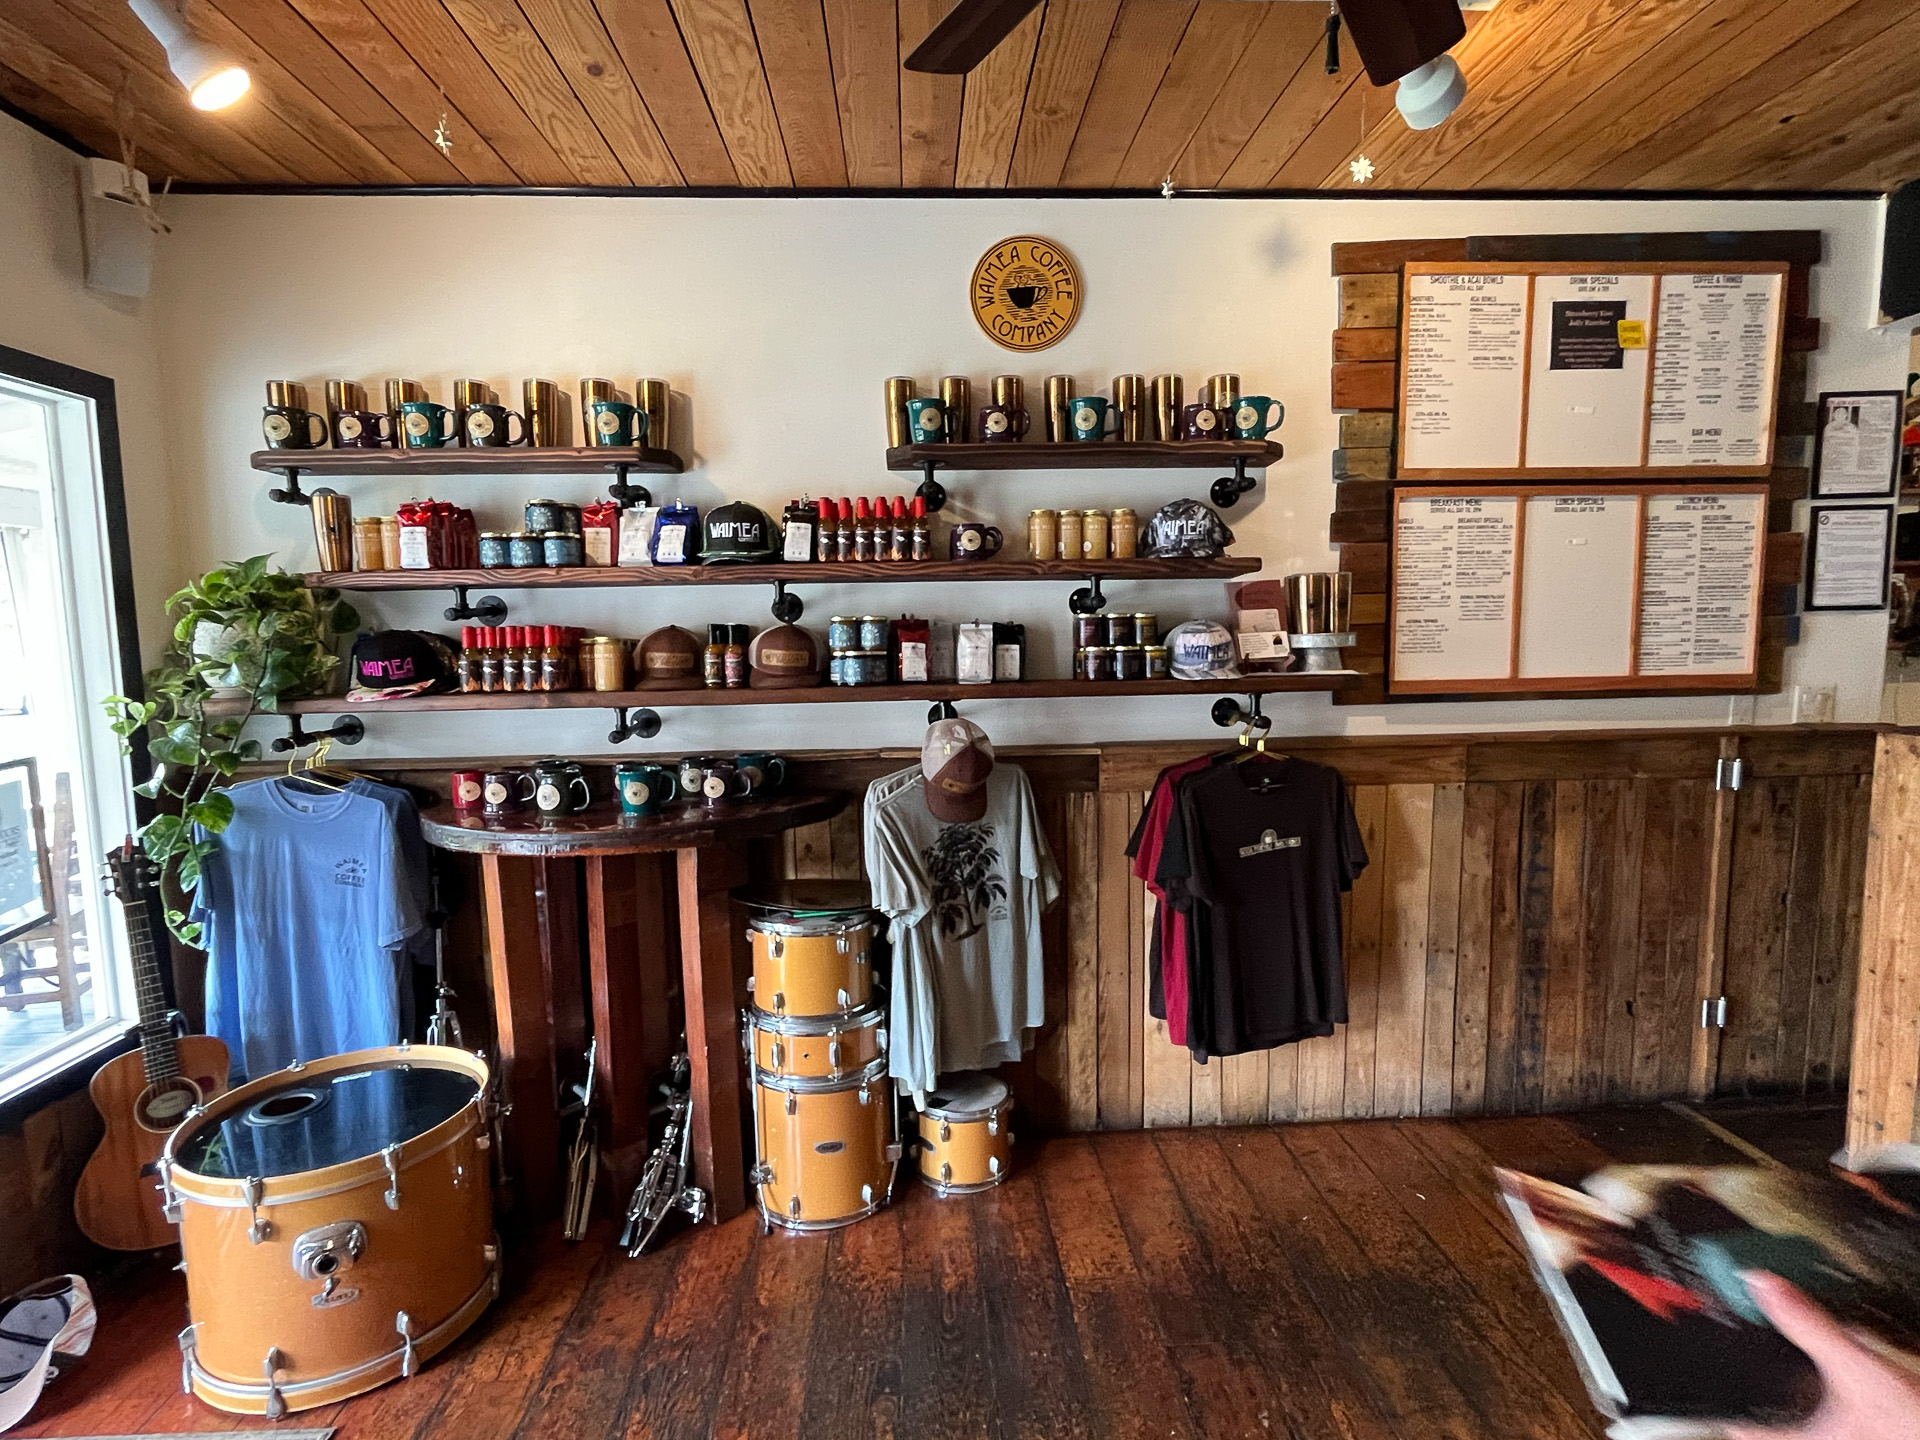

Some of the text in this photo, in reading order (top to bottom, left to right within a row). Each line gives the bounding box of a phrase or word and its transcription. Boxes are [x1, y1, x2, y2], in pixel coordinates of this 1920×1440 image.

[978, 245, 1072, 309] WAIMEA COFFEE
[1430, 275, 1504, 285] SMOOTHIE & ACAI BOWLS
[1569, 276, 1619, 285] DRINK SPECIALS
[1692, 275, 1715, 284] COFFEE
[992, 309, 1065, 342] COMPANY
[1576, 497, 1605, 506] SPECIALS
[710, 522, 760, 538] WAIMEA
[1183, 643, 1229, 660] WAIMEA
[359, 656, 414, 676] WAIMEA
[334, 858, 367, 874] WAIMEA
